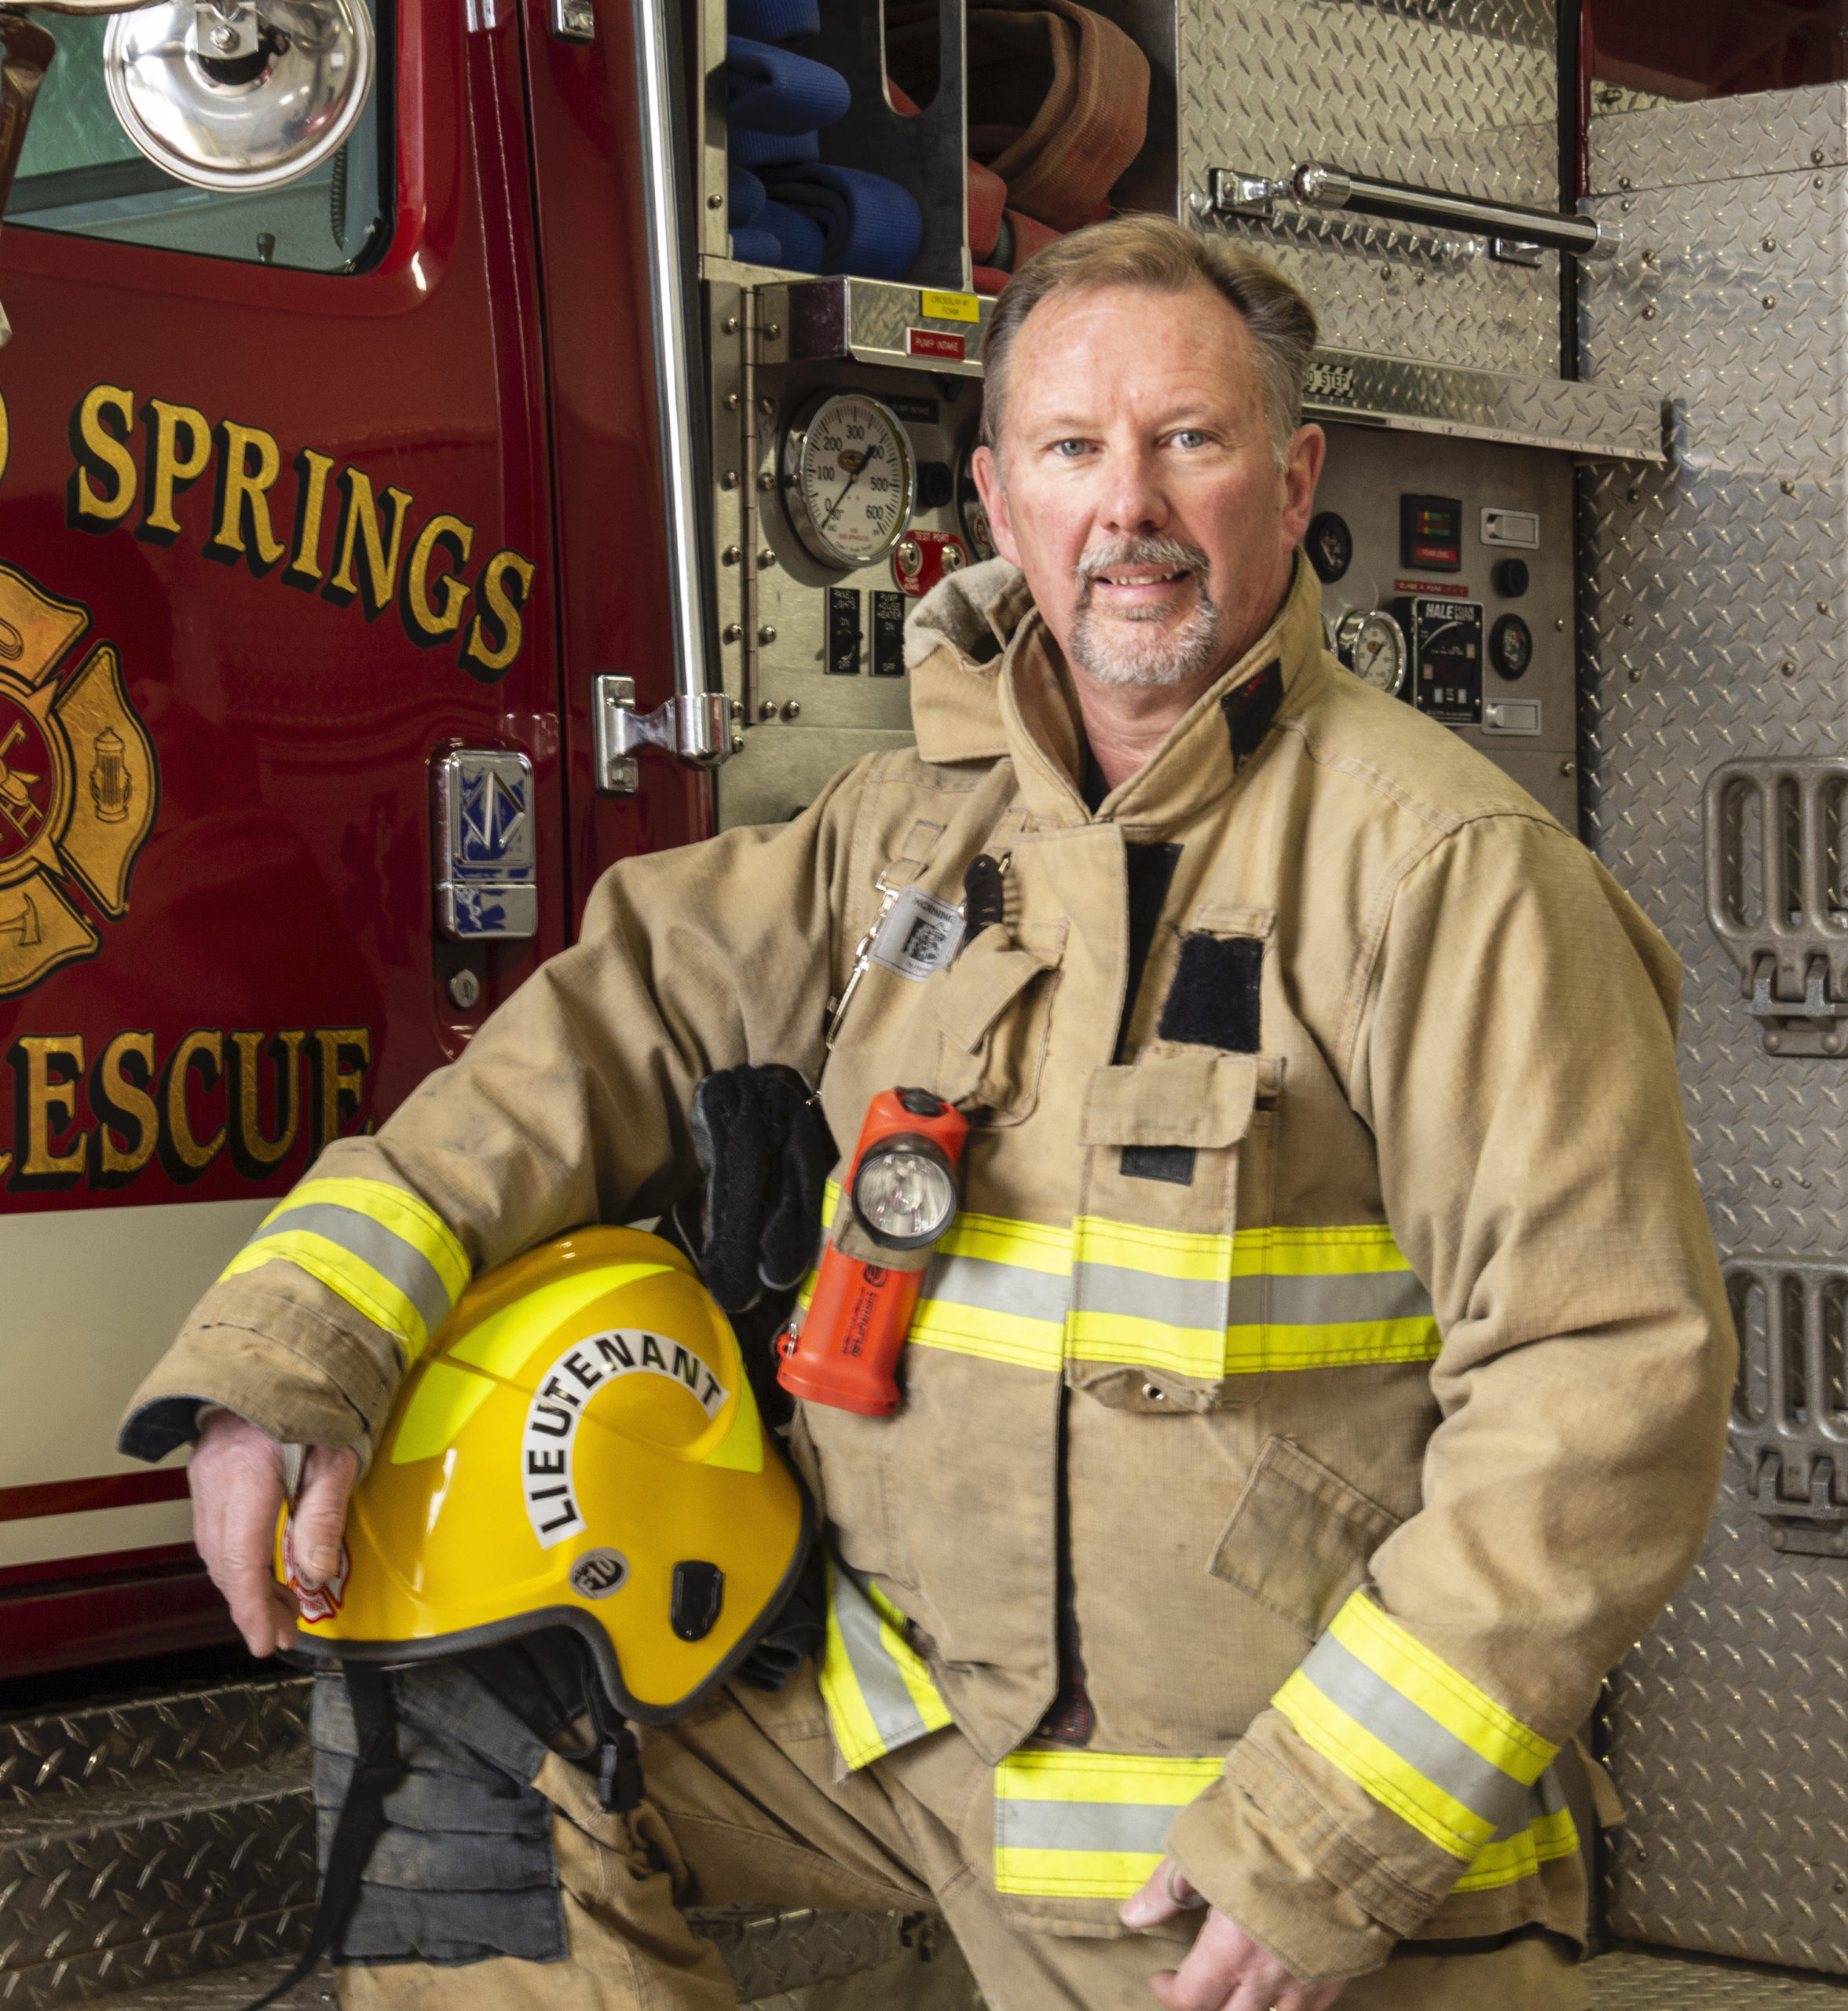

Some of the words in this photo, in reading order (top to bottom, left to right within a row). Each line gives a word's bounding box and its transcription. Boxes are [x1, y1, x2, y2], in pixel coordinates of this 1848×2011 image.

[915, 336, 935, 348] PUMP
[936, 340, 959, 352] INTAKE
[1321, 372, 1347, 388] STEP
[846, 424, 865, 440] 300
[823, 436, 843, 452] 200
[817, 465, 835, 481] 100
[870, 476, 889, 492] 500
[865, 504, 884, 520] 600
[69, 383, 536, 680] SPRINGS
[914, 530, 931, 542] TEST
[931, 533, 950, 544] PORT
[833, 589, 855, 600] PANEL
[1425, 603, 1454, 620] HALE
[0, 1026, 374, 1190] ESCUE
[527, 1332, 721, 1534] LIEUTENANT
